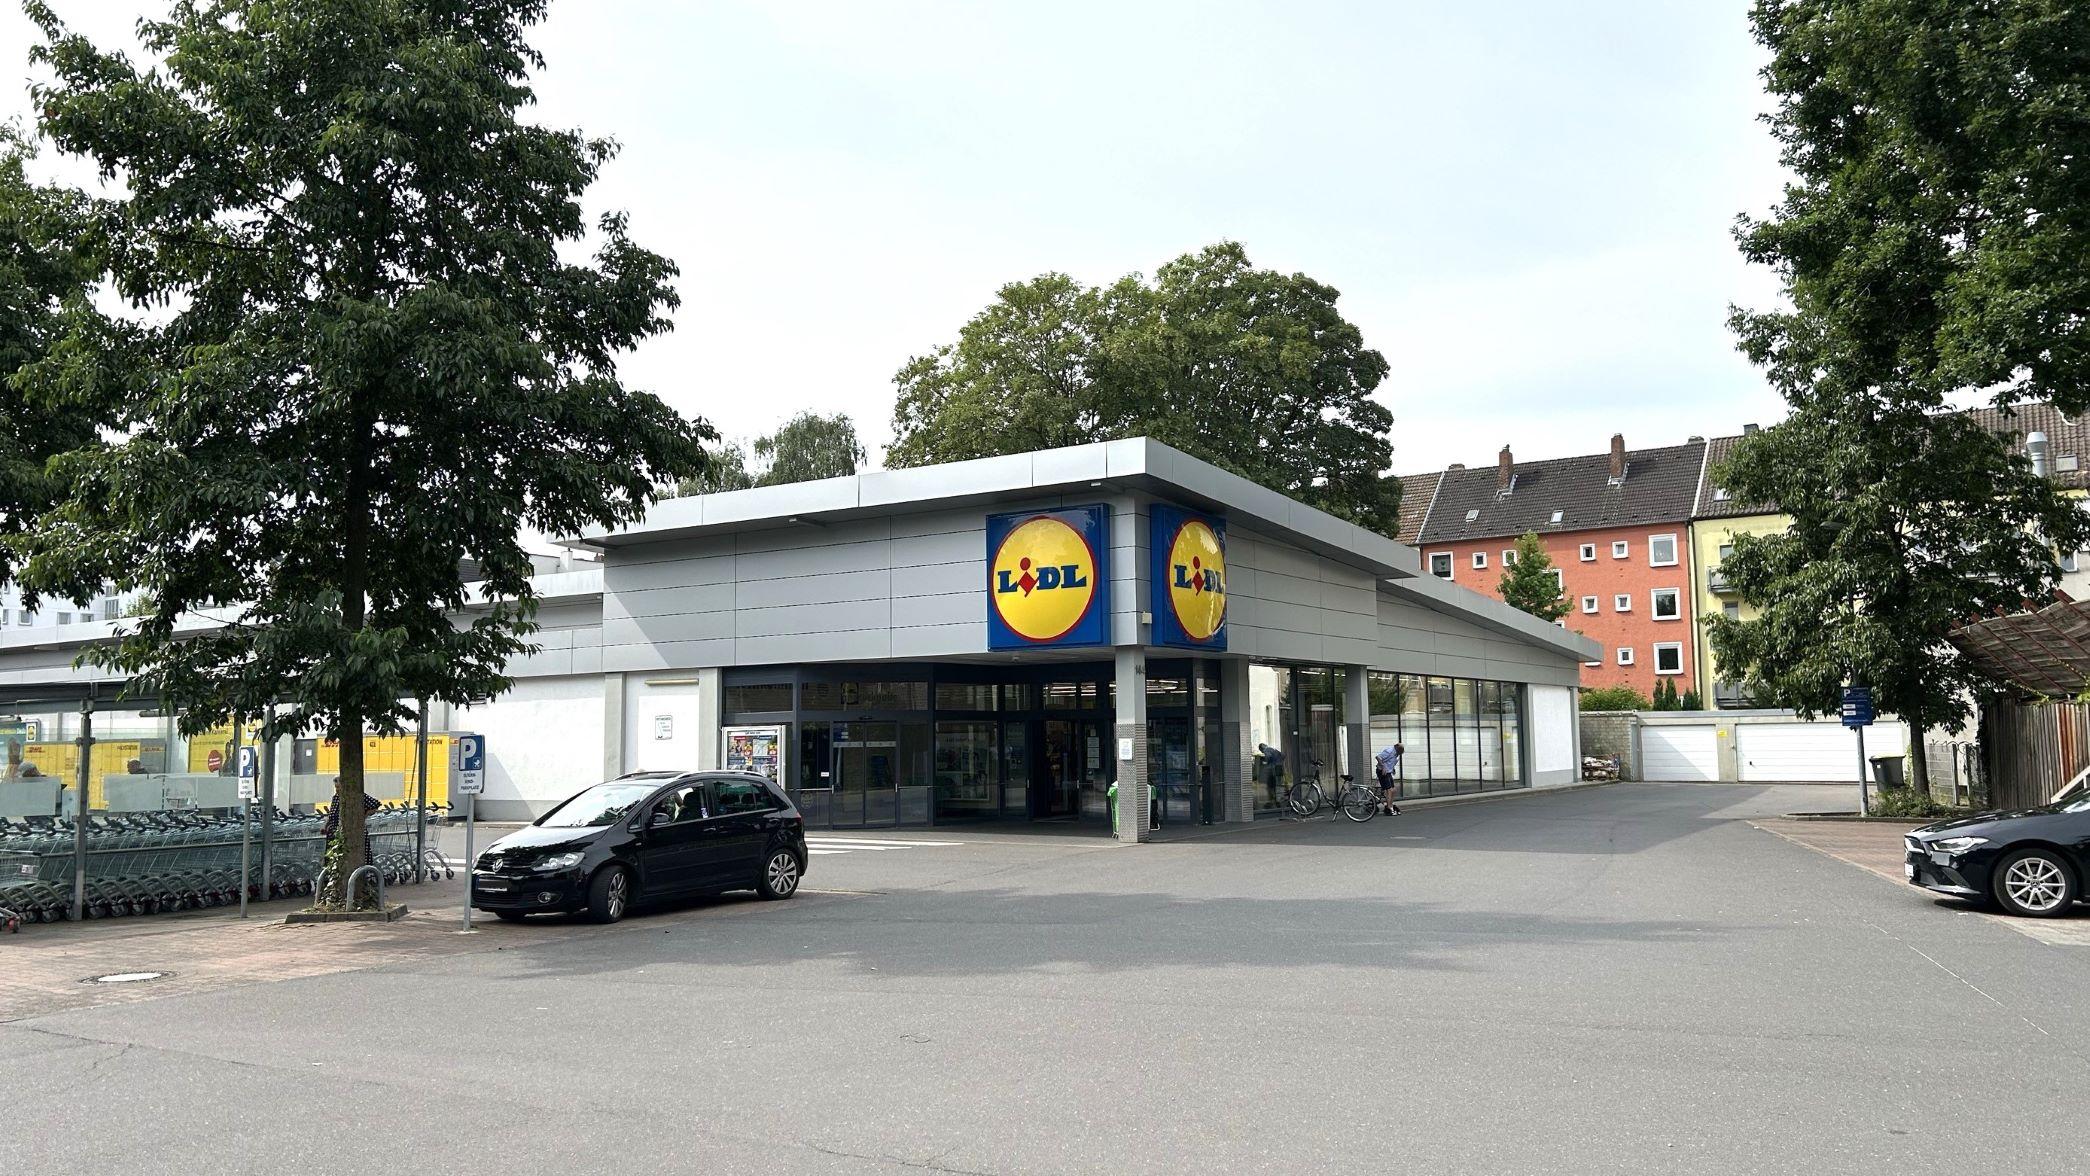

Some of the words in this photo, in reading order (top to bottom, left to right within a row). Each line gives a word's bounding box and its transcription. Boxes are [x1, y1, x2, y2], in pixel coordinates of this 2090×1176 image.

[1843, 689, 1851, 697] P
[240, 749, 251, 777] P
[460, 738, 477, 770] P
